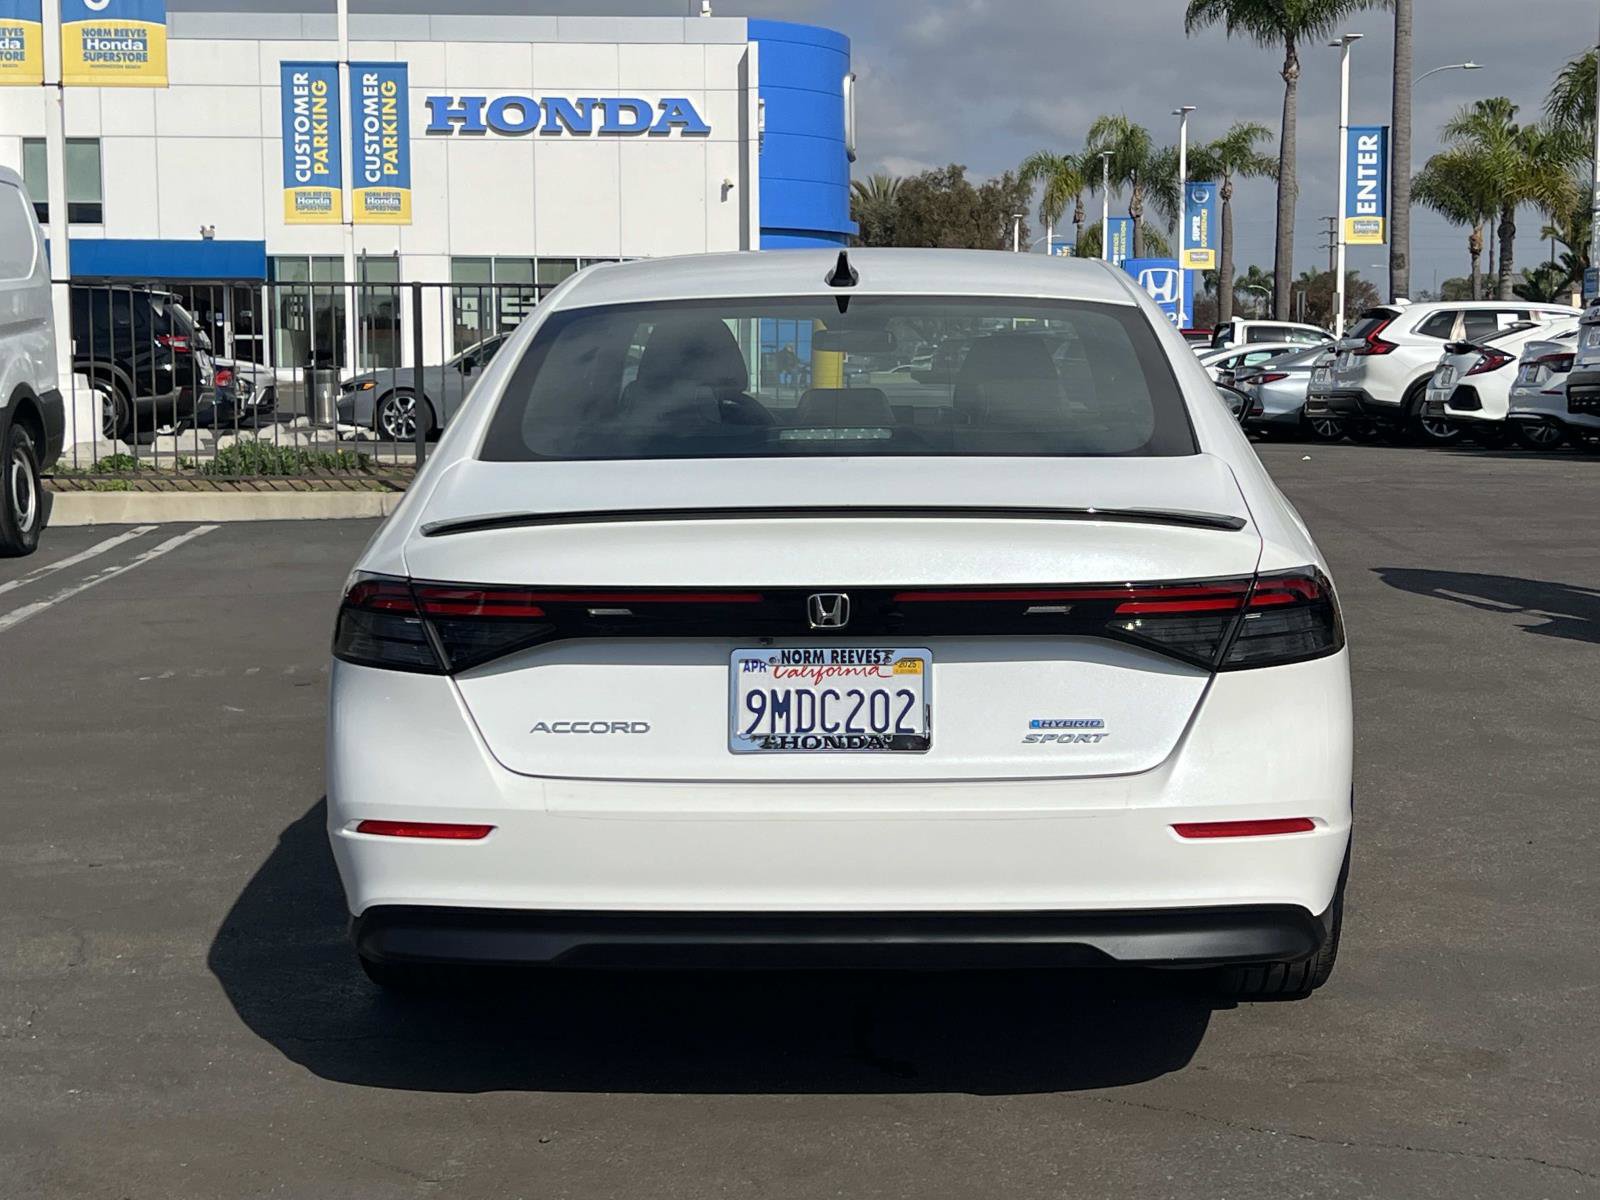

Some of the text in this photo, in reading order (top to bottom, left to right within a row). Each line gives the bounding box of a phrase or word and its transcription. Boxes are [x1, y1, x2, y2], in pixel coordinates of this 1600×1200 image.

[81, 28, 147, 37] NORM REEVES
[86, 38, 144, 50] Honda
[82, 51, 148, 62] SUPERSTORE
[425, 96, 711, 137] HONDA
[293, 72, 311, 182] CUSTOMER
[311, 80, 329, 174] PARKING
[362, 72, 381, 182] CUSTOMER
[381, 80, 398, 175] PARKING
[1357, 134, 1378, 214] ENTER
[297, 197, 330, 205] Honda
[366, 197, 399, 205] Honda
[781, 649, 881, 664] NORM REEVES
[743, 661, 767, 673] APR
[773, 664, 893, 686] California
[746, 689, 916, 734] 9MDC202
[529, 721, 651, 734] ACCORD
[1041, 719, 1101, 728] HYBRID
[780, 735, 885, 750] HONDA
[1021, 733, 1110, 744] SPORT
